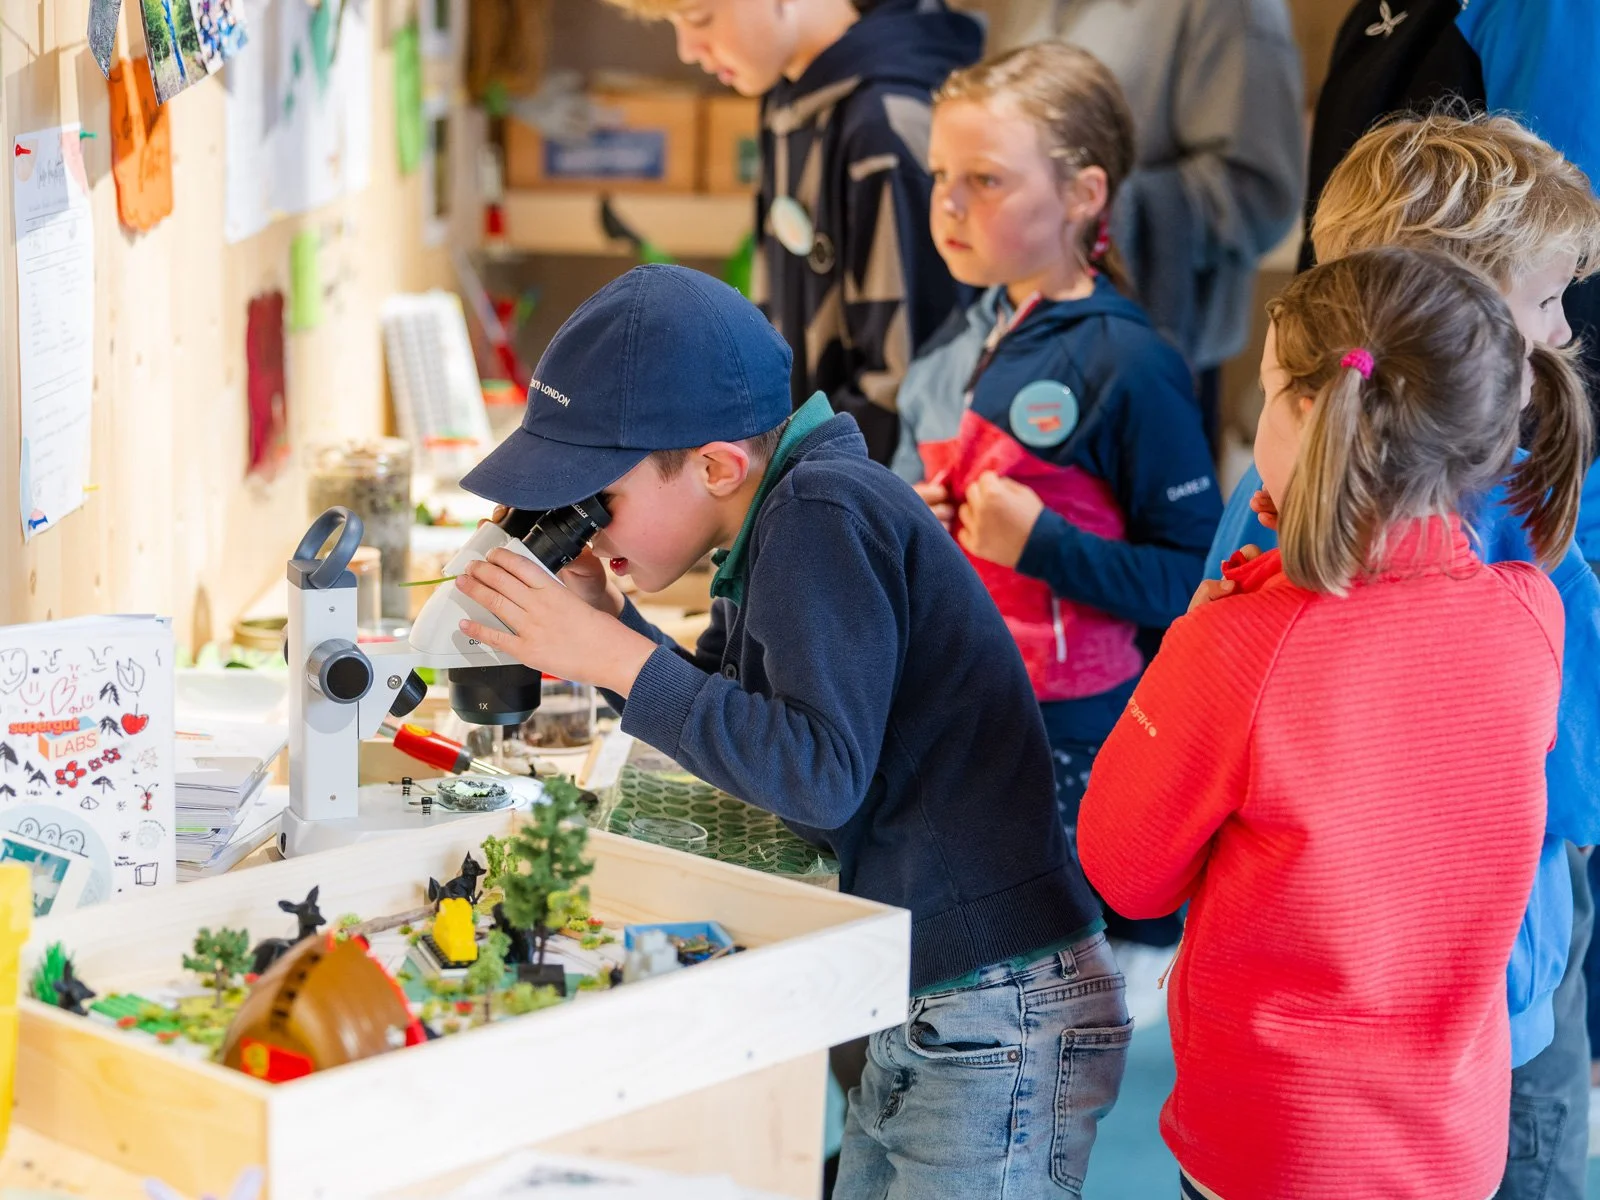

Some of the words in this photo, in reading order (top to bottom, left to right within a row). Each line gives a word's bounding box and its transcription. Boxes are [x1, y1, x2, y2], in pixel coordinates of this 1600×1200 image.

[541, 383, 571, 407] LONDON
[469, 638, 482, 646] OS
[478, 702, 488, 710] 1X
[9, 717, 80, 736] supergut
[55, 732, 97, 758] LABS
